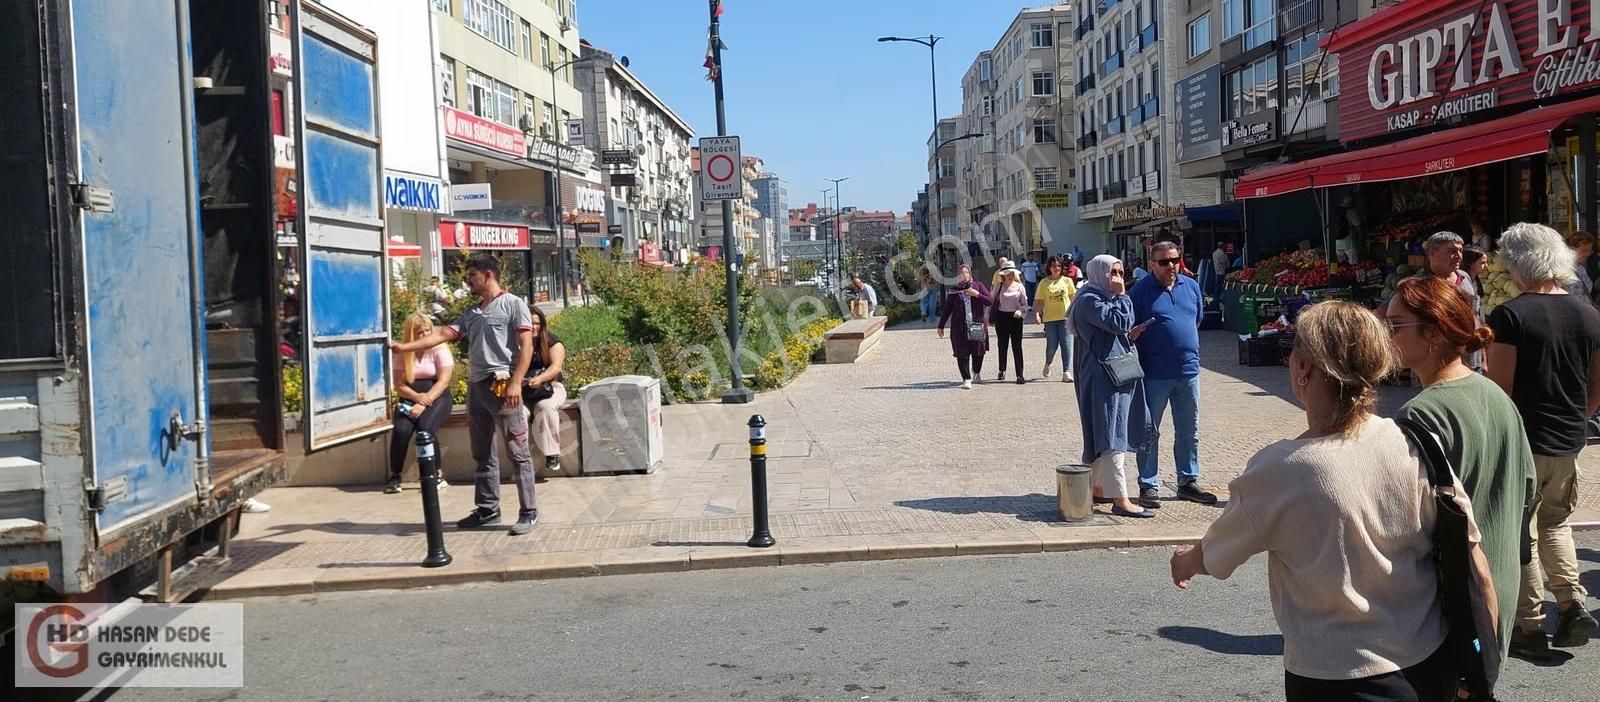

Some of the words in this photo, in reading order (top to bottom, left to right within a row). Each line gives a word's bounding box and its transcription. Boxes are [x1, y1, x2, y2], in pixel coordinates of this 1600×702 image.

[1367, 2, 1522, 111] GIPTA
[1233, 125, 1248, 139] Bella
[1248, 122, 1269, 135] Femme
[1387, 110, 1420, 131] KASAP
[456, 118, 474, 139] AYNA
[473, 120, 496, 146] SÜRÜCÜ
[469, 225, 501, 244] BURGER
[501, 227, 519, 245] KING
